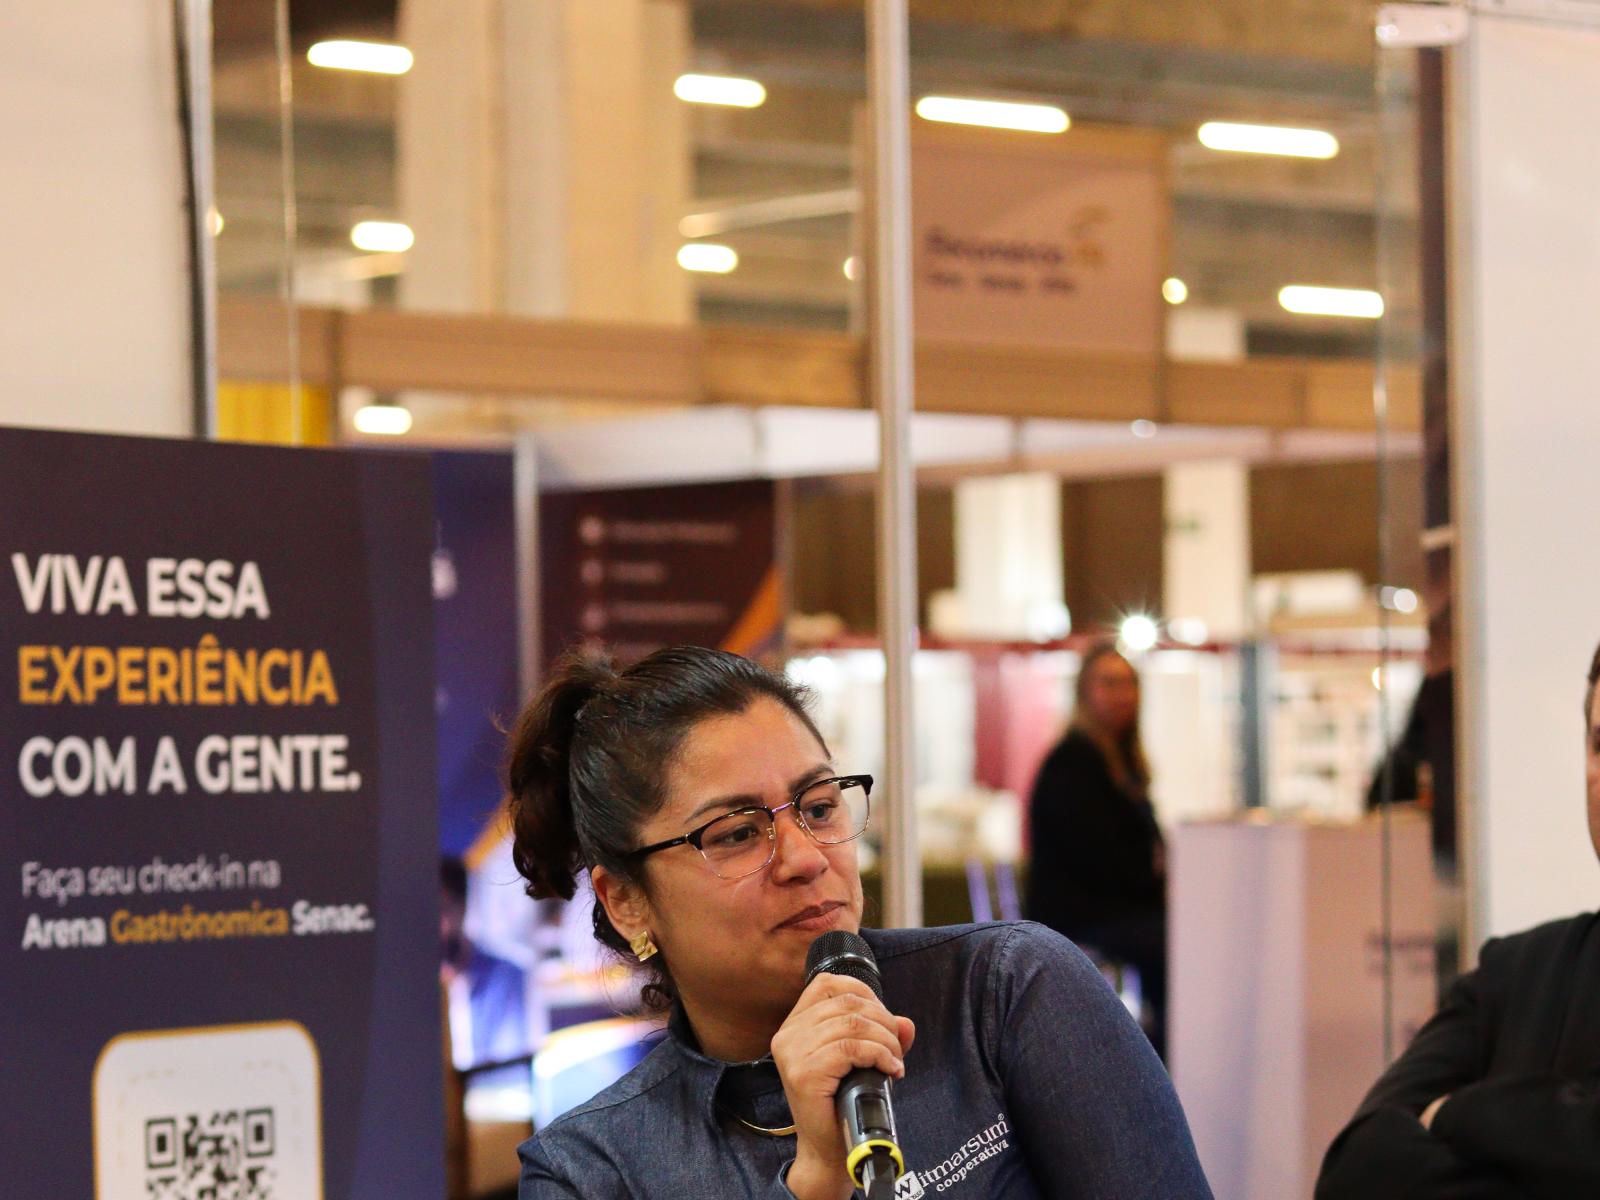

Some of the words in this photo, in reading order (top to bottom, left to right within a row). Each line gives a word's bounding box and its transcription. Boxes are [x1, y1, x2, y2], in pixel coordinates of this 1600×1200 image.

[12, 553, 137, 616] VIVA
[147, 557, 270, 619] ESSA
[18, 633, 339, 705] EXPERIÊNCIA
[18, 735, 136, 797] COM
[148, 735, 187, 795] A
[195, 734, 362, 793] GENTE.
[22, 861, 86, 907] Faça
[88, 865, 137, 896] seu
[138, 854, 244, 893] check-in
[247, 859, 281, 889] na
[22, 913, 106, 949] Arena
[291, 899, 375, 936] Senac.
[936, 1139, 1009, 1192] cooperativa
